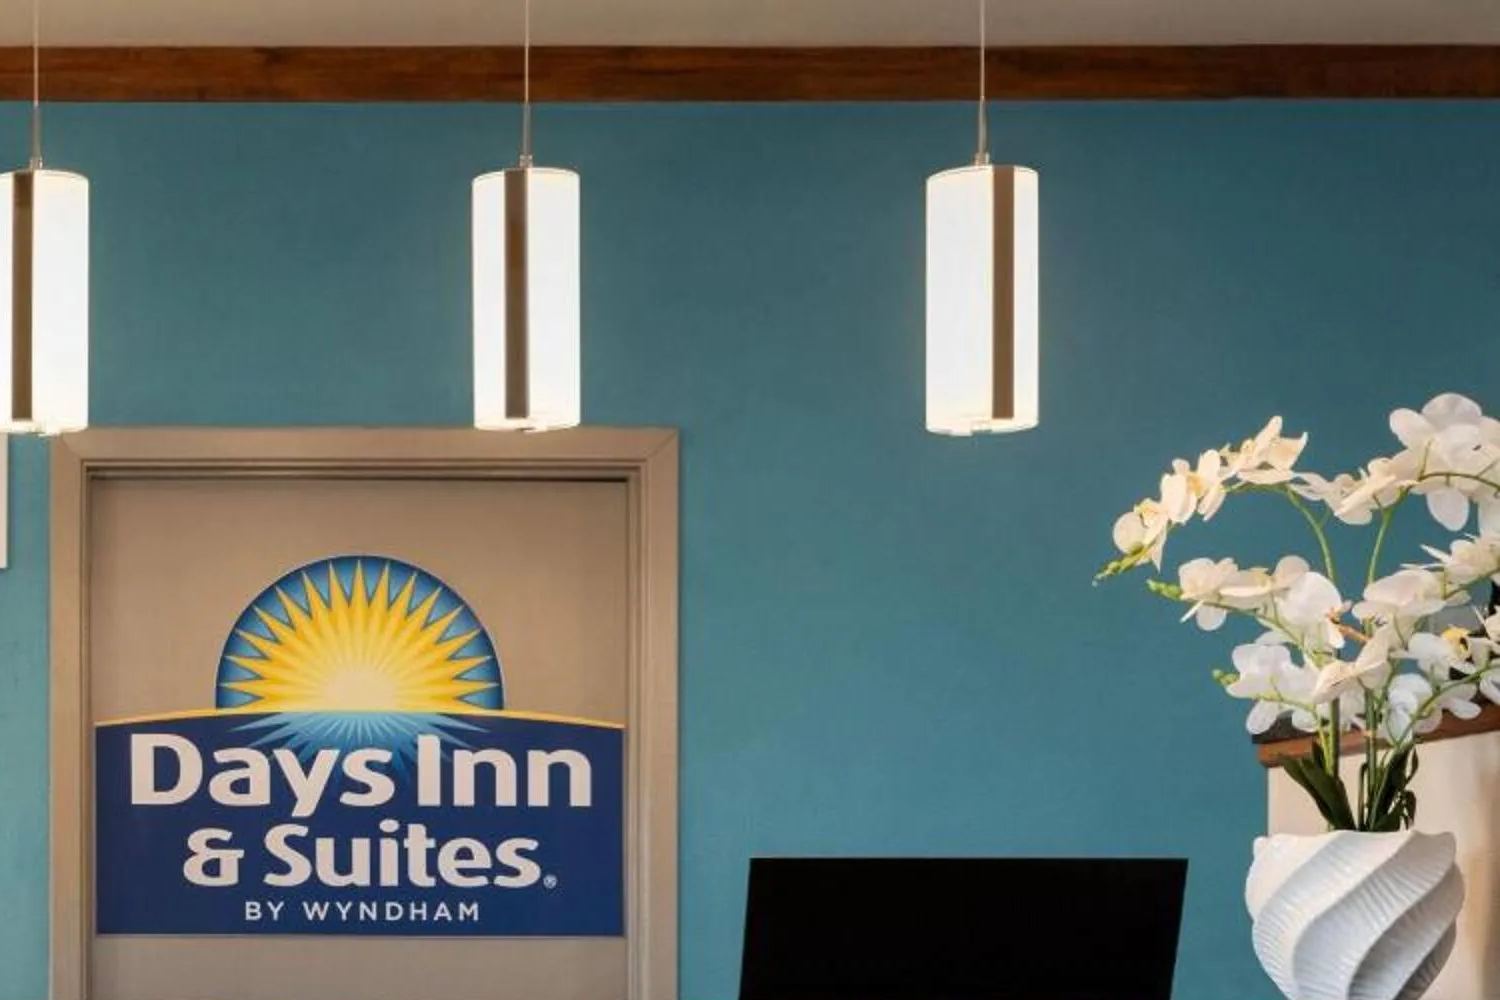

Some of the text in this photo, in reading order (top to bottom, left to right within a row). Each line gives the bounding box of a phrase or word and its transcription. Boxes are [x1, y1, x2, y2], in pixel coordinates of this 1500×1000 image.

[130, 733, 592, 818] Days Inn
[183, 828, 245, 887] &
[245, 901, 479, 921] BY WYNDHAM
